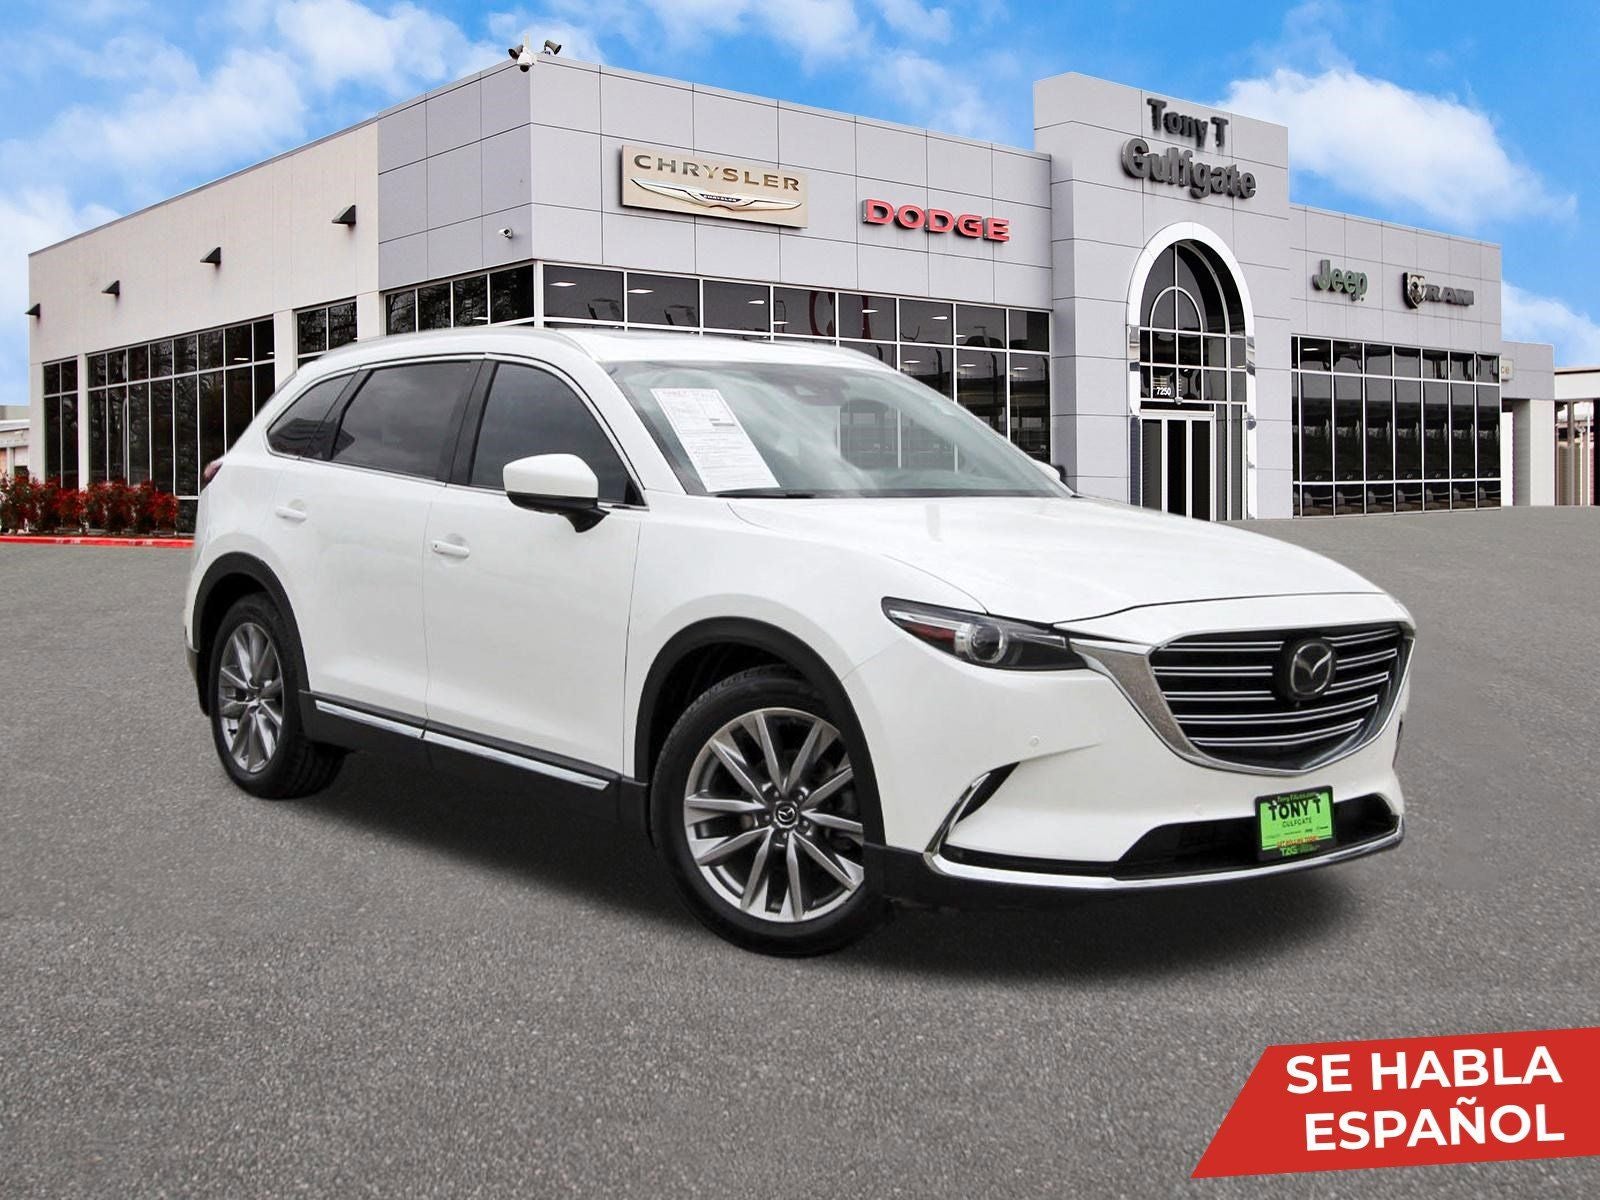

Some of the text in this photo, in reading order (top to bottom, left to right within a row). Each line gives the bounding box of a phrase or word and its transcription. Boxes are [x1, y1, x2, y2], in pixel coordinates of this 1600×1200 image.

[1146, 98, 1229, 148] Tony T
[633, 154, 800, 192] CHRYSLER
[1120, 138, 1257, 199] Gulfgate
[862, 198, 1010, 241] DODGE
[1312, 259, 1368, 302] Jeep
[1425, 284, 1475, 306] RAM
[1156, 386, 1172, 396] 7250
[1268, 799, 1310, 822] TONY
[1312, 797, 1322, 814] T
